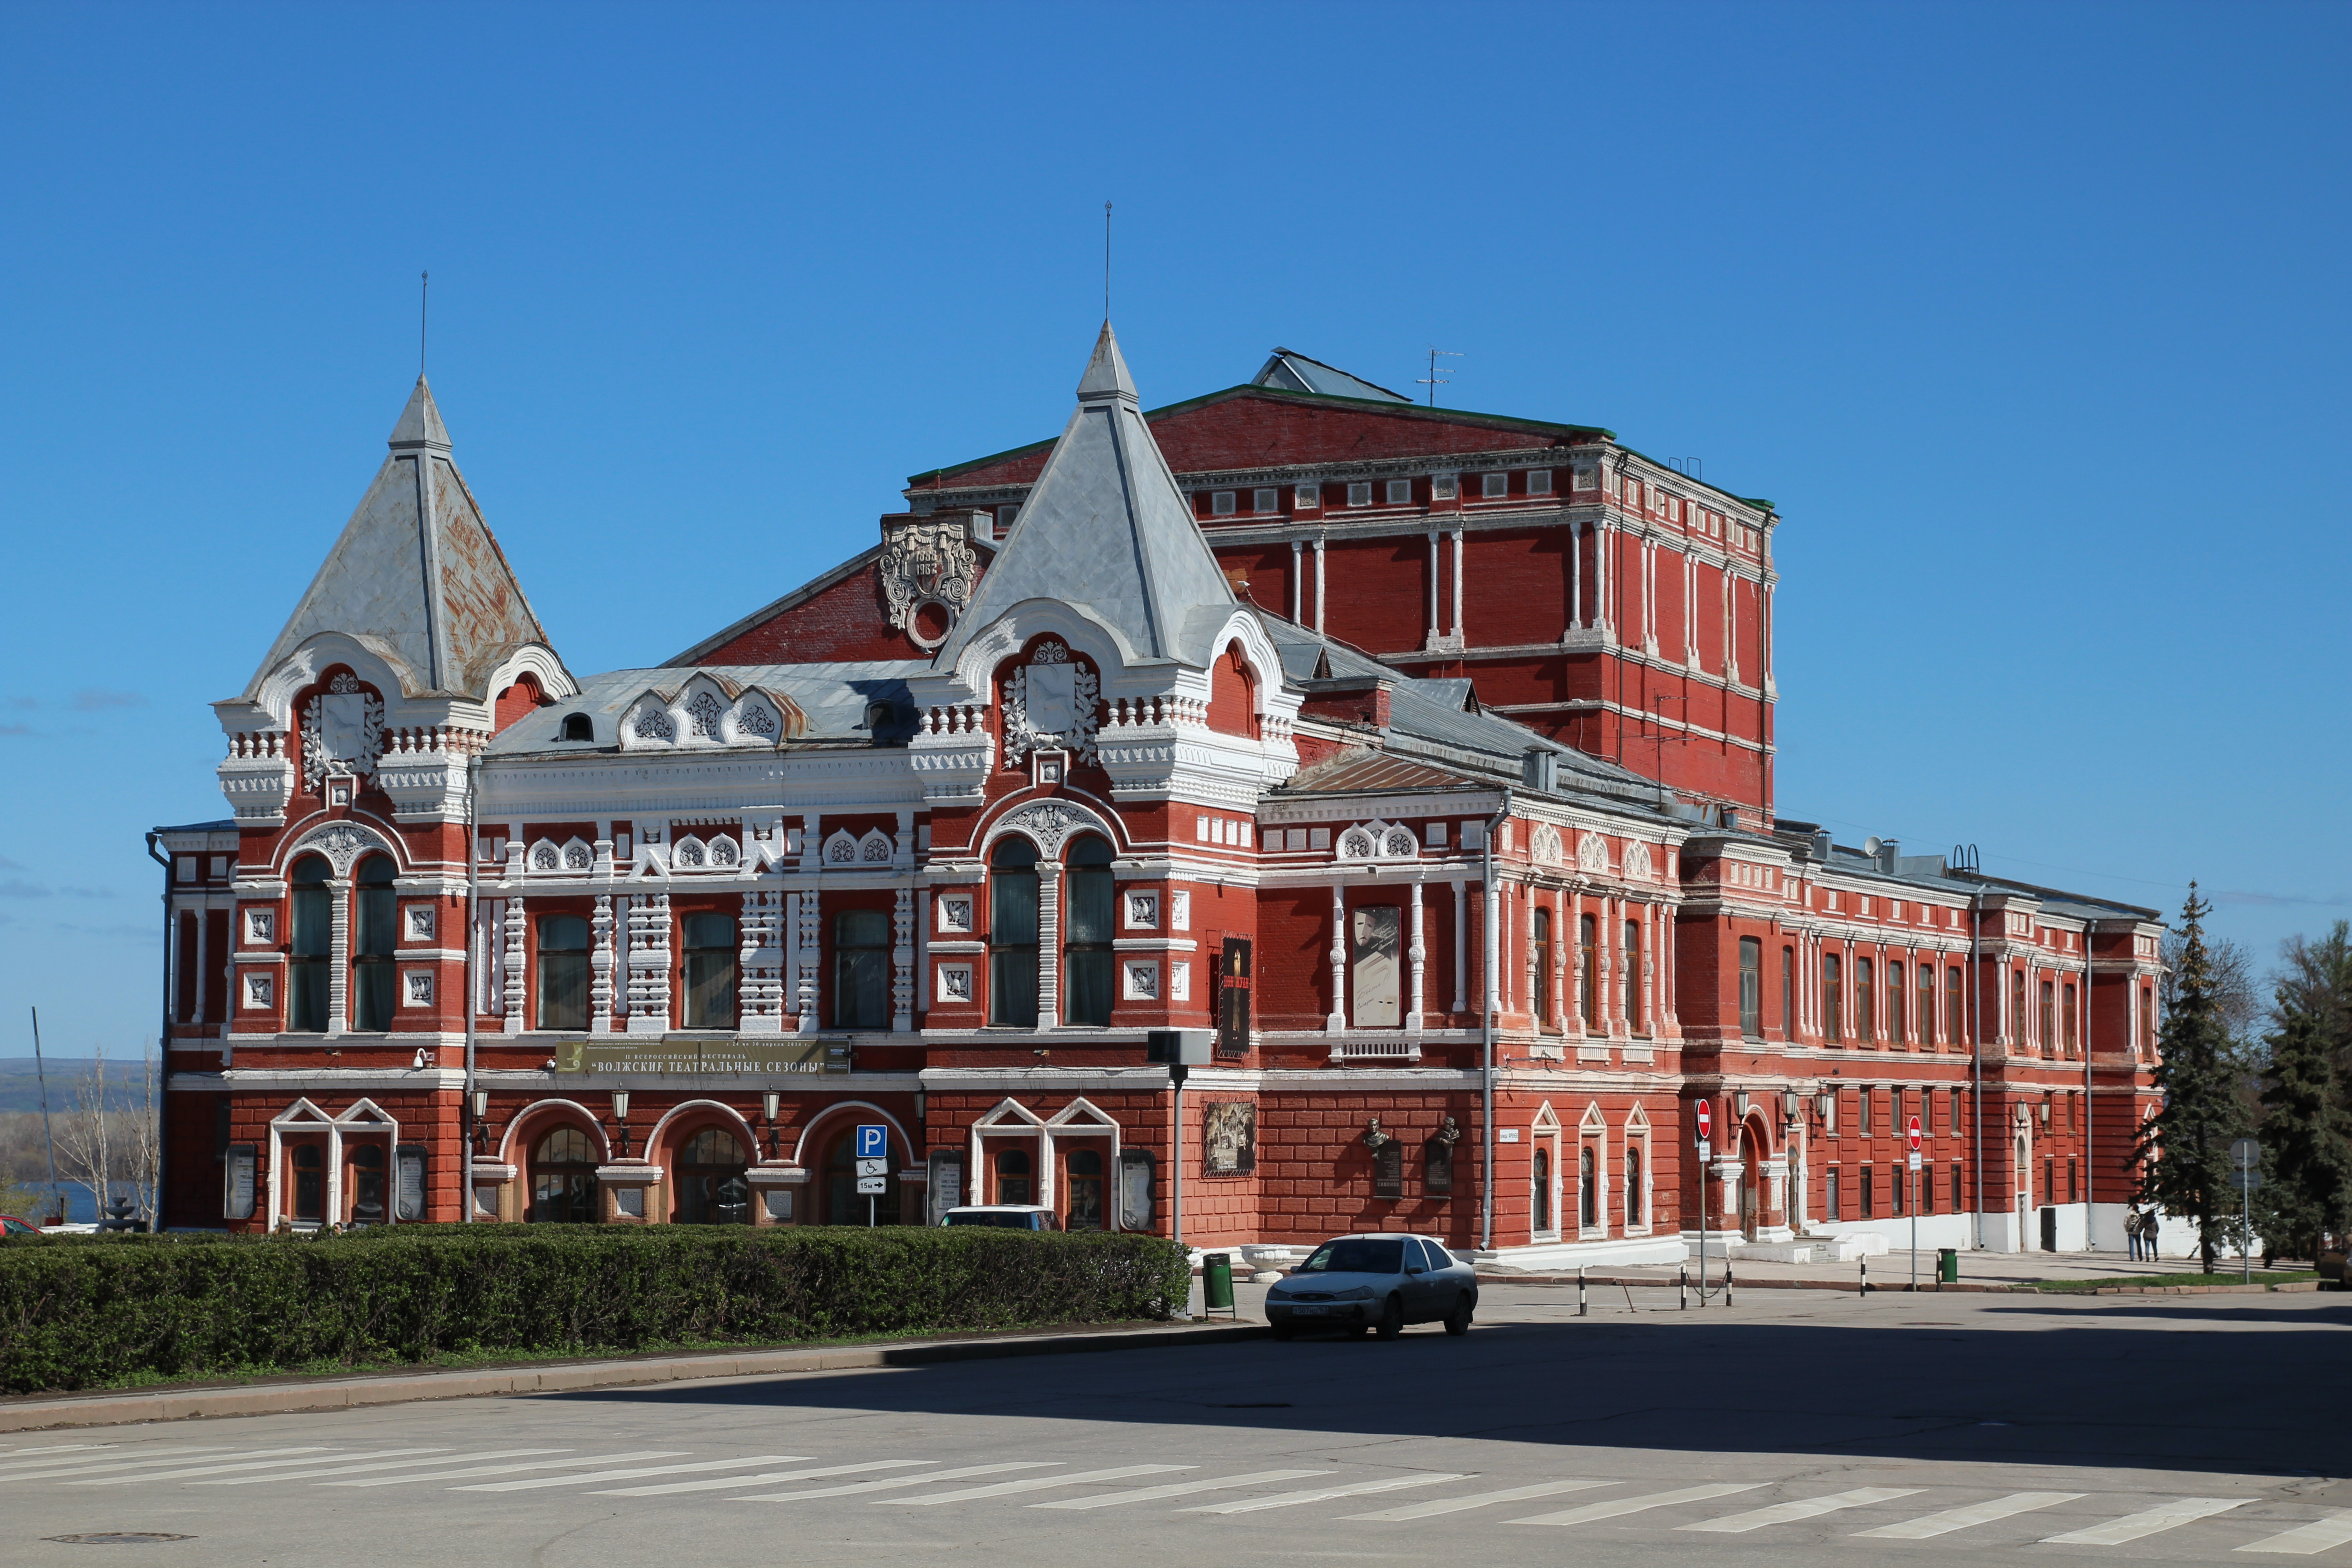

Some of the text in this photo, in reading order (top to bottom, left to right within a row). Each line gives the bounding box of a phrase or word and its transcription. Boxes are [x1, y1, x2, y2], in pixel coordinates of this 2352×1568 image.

[916, 550, 937, 562] 1888
[916, 563, 937, 575] 1962
[1223, 975, 1249, 989] ДОН ЖУАН
[669, 1061, 761, 1072] ТЕАТРАЛЬНЫЕ
[865, 1129, 881, 1154] P
